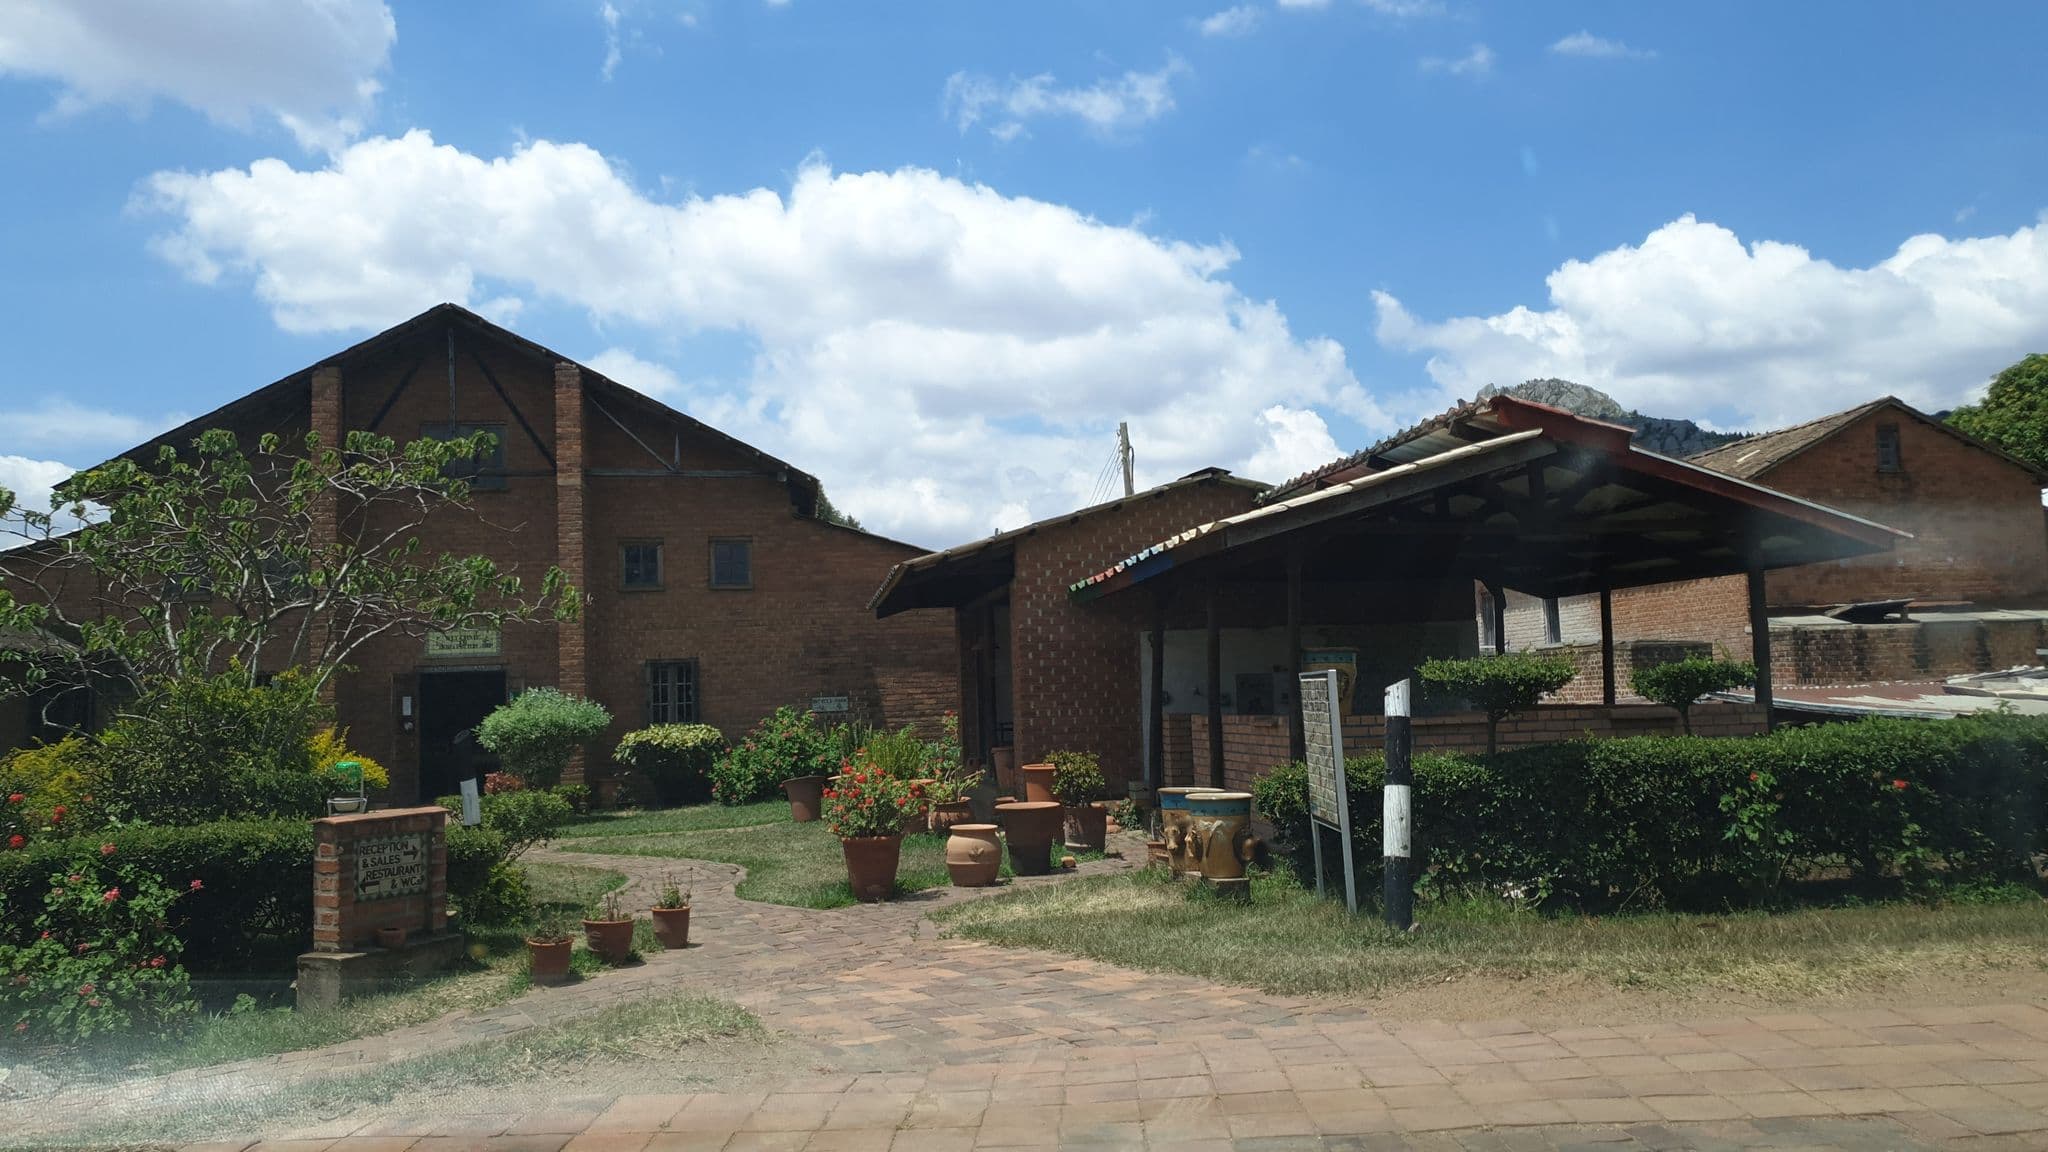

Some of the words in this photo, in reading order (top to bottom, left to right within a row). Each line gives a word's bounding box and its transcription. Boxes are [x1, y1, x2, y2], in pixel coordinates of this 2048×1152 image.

[360, 841, 409, 856] RECEPTION
[362, 858, 369, 868] &
[370, 855, 401, 867] SALES
[366, 864, 421, 880] RESTAURANT
[391, 879, 398, 889] &
